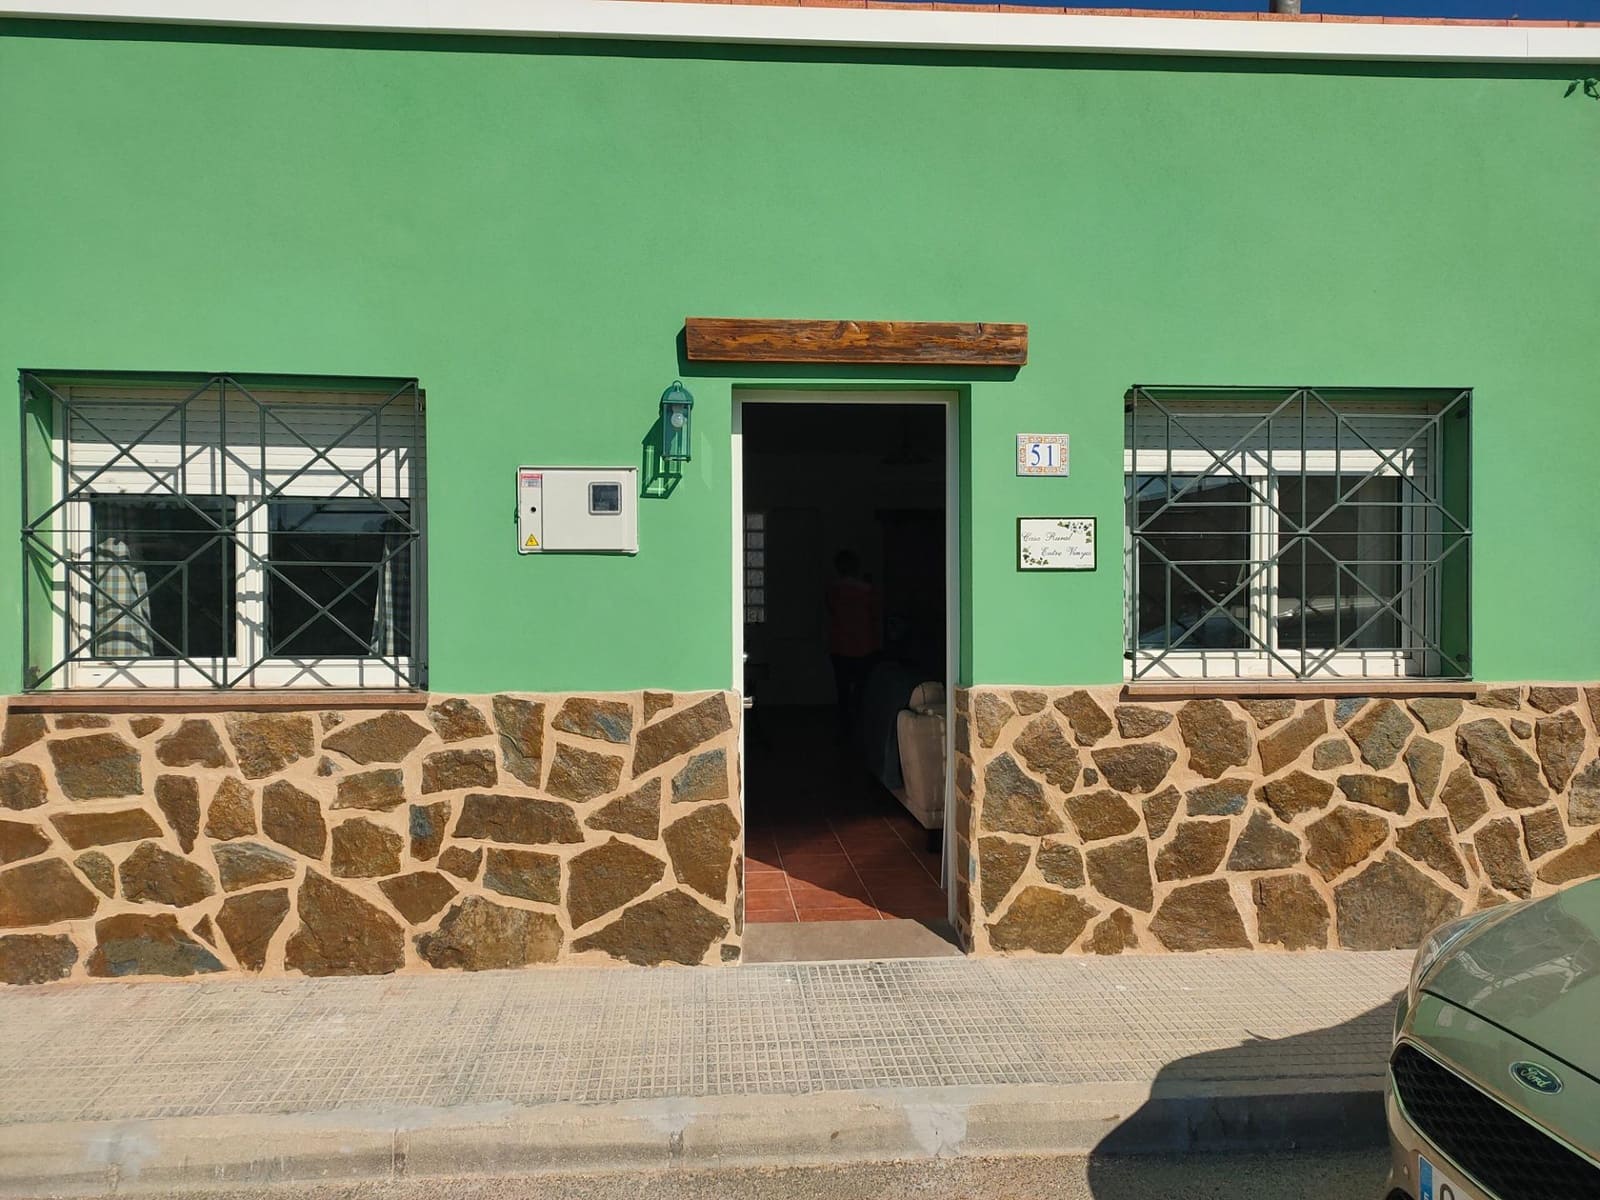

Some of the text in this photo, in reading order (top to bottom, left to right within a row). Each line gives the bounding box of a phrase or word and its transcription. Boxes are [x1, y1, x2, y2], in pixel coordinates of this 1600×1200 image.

[1031, 444, 1053, 467] 51
[1045, 531, 1074, 542] Rural
[1041, 546, 1062, 557] Entre
[1520, 1066, 1552, 1088] Ford
